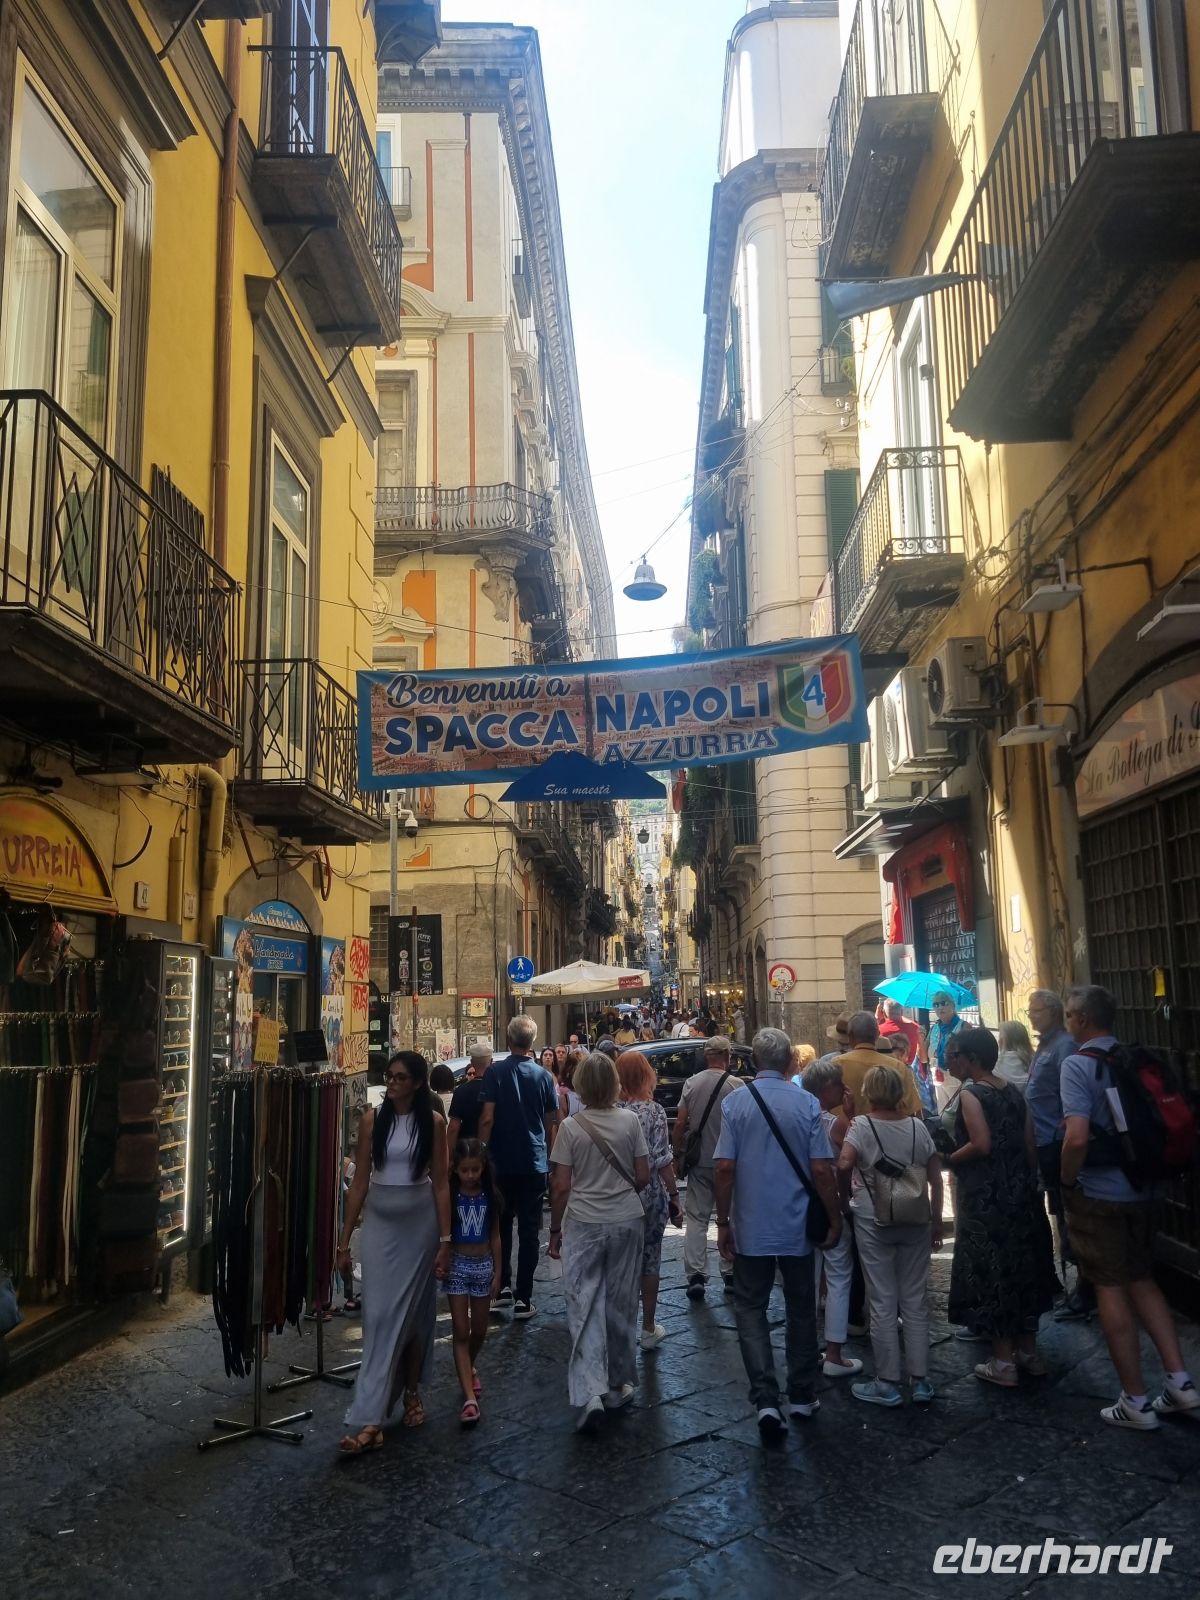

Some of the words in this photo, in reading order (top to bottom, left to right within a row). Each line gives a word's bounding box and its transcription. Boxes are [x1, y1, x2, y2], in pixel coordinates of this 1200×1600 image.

[386, 673, 542, 709] Benvenuti
[546, 676, 572, 697] a
[595, 681, 770, 734] NAPOLI
[801, 674, 826, 706] 4
[384, 708, 579, 756] SPACCA
[602, 727, 777, 764] AZZURRA
[1167, 713, 1185, 758] di
[543, 783, 568, 797] Sua
[457, 1205, 488, 1237] W
